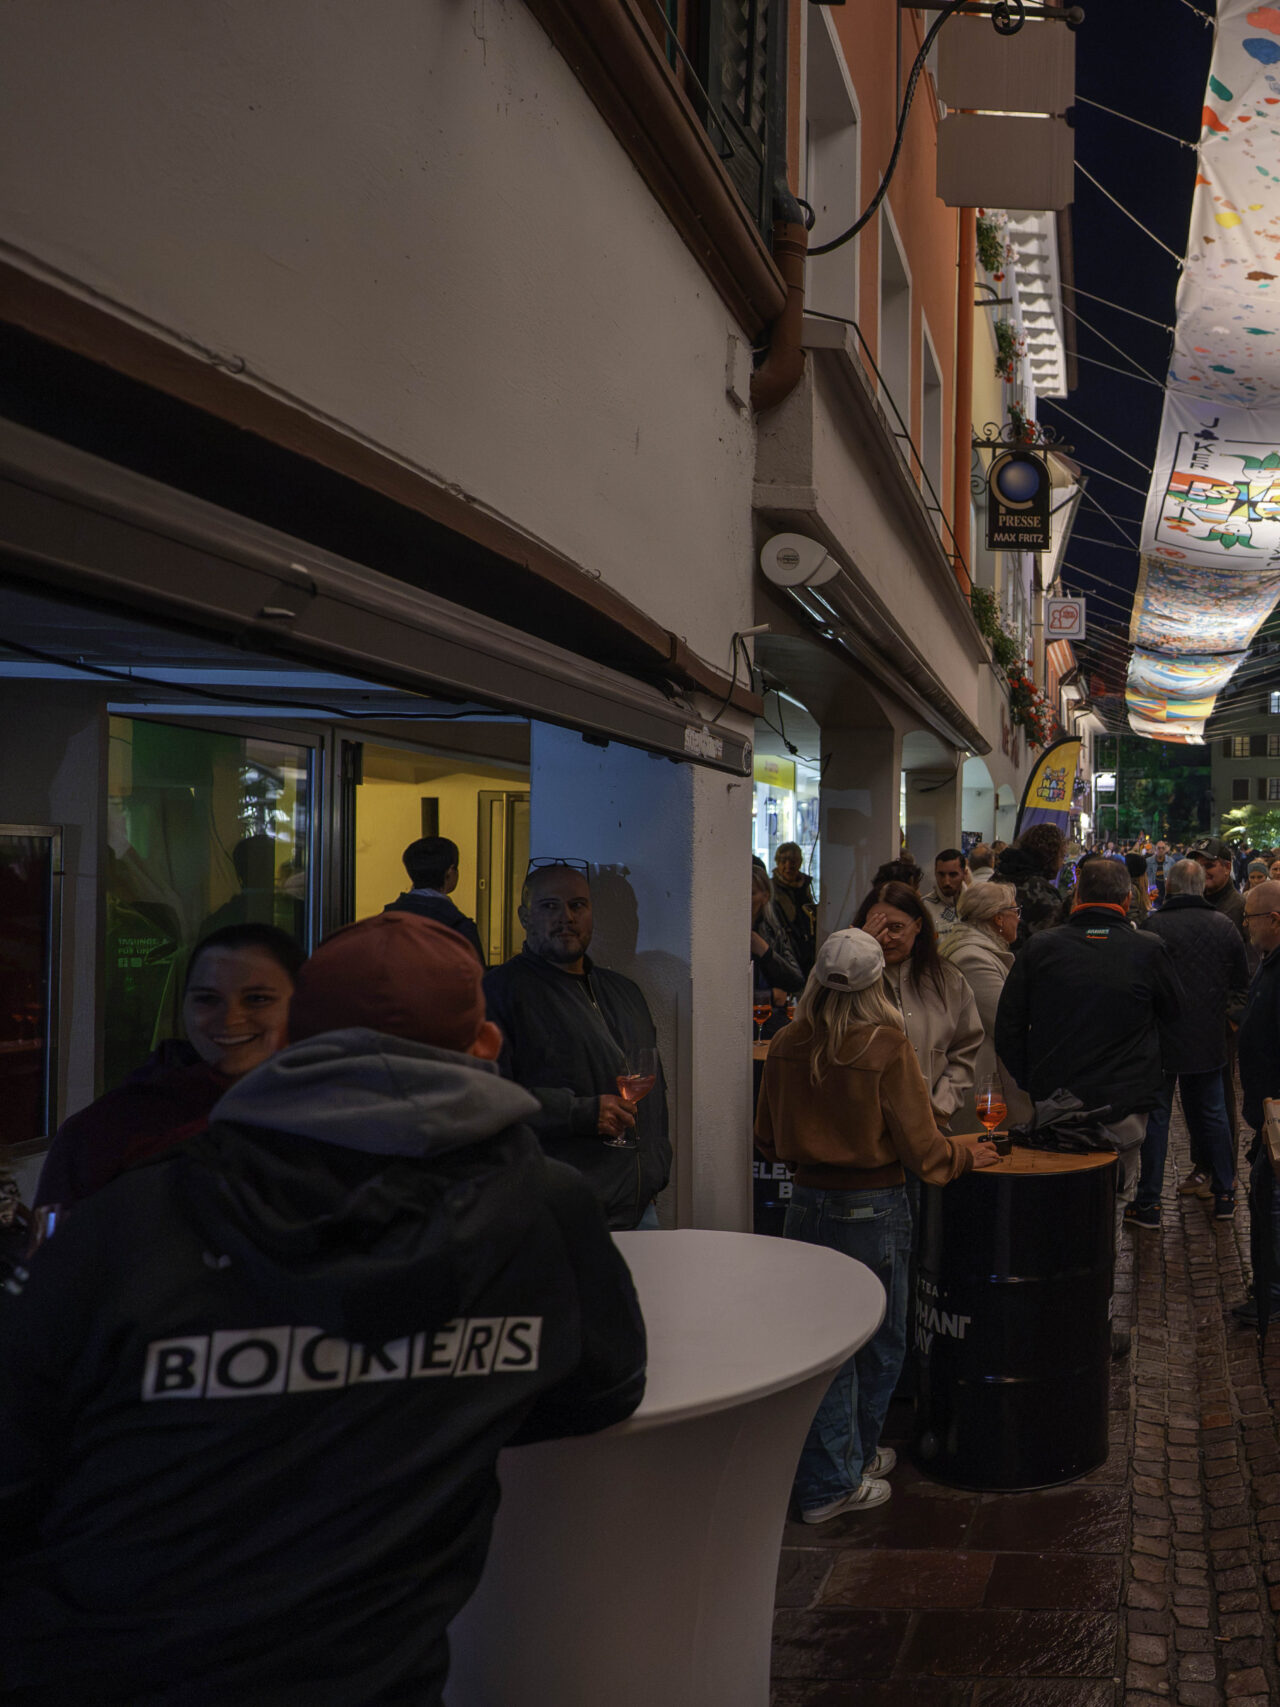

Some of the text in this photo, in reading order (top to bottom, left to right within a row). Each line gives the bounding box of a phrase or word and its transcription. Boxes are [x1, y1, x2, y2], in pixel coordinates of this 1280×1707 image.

[999, 514, 1041, 528] PRESSE
[993, 532, 1044, 543] MAX FRITZ
[148, 1319, 538, 1397] BOCKERS
